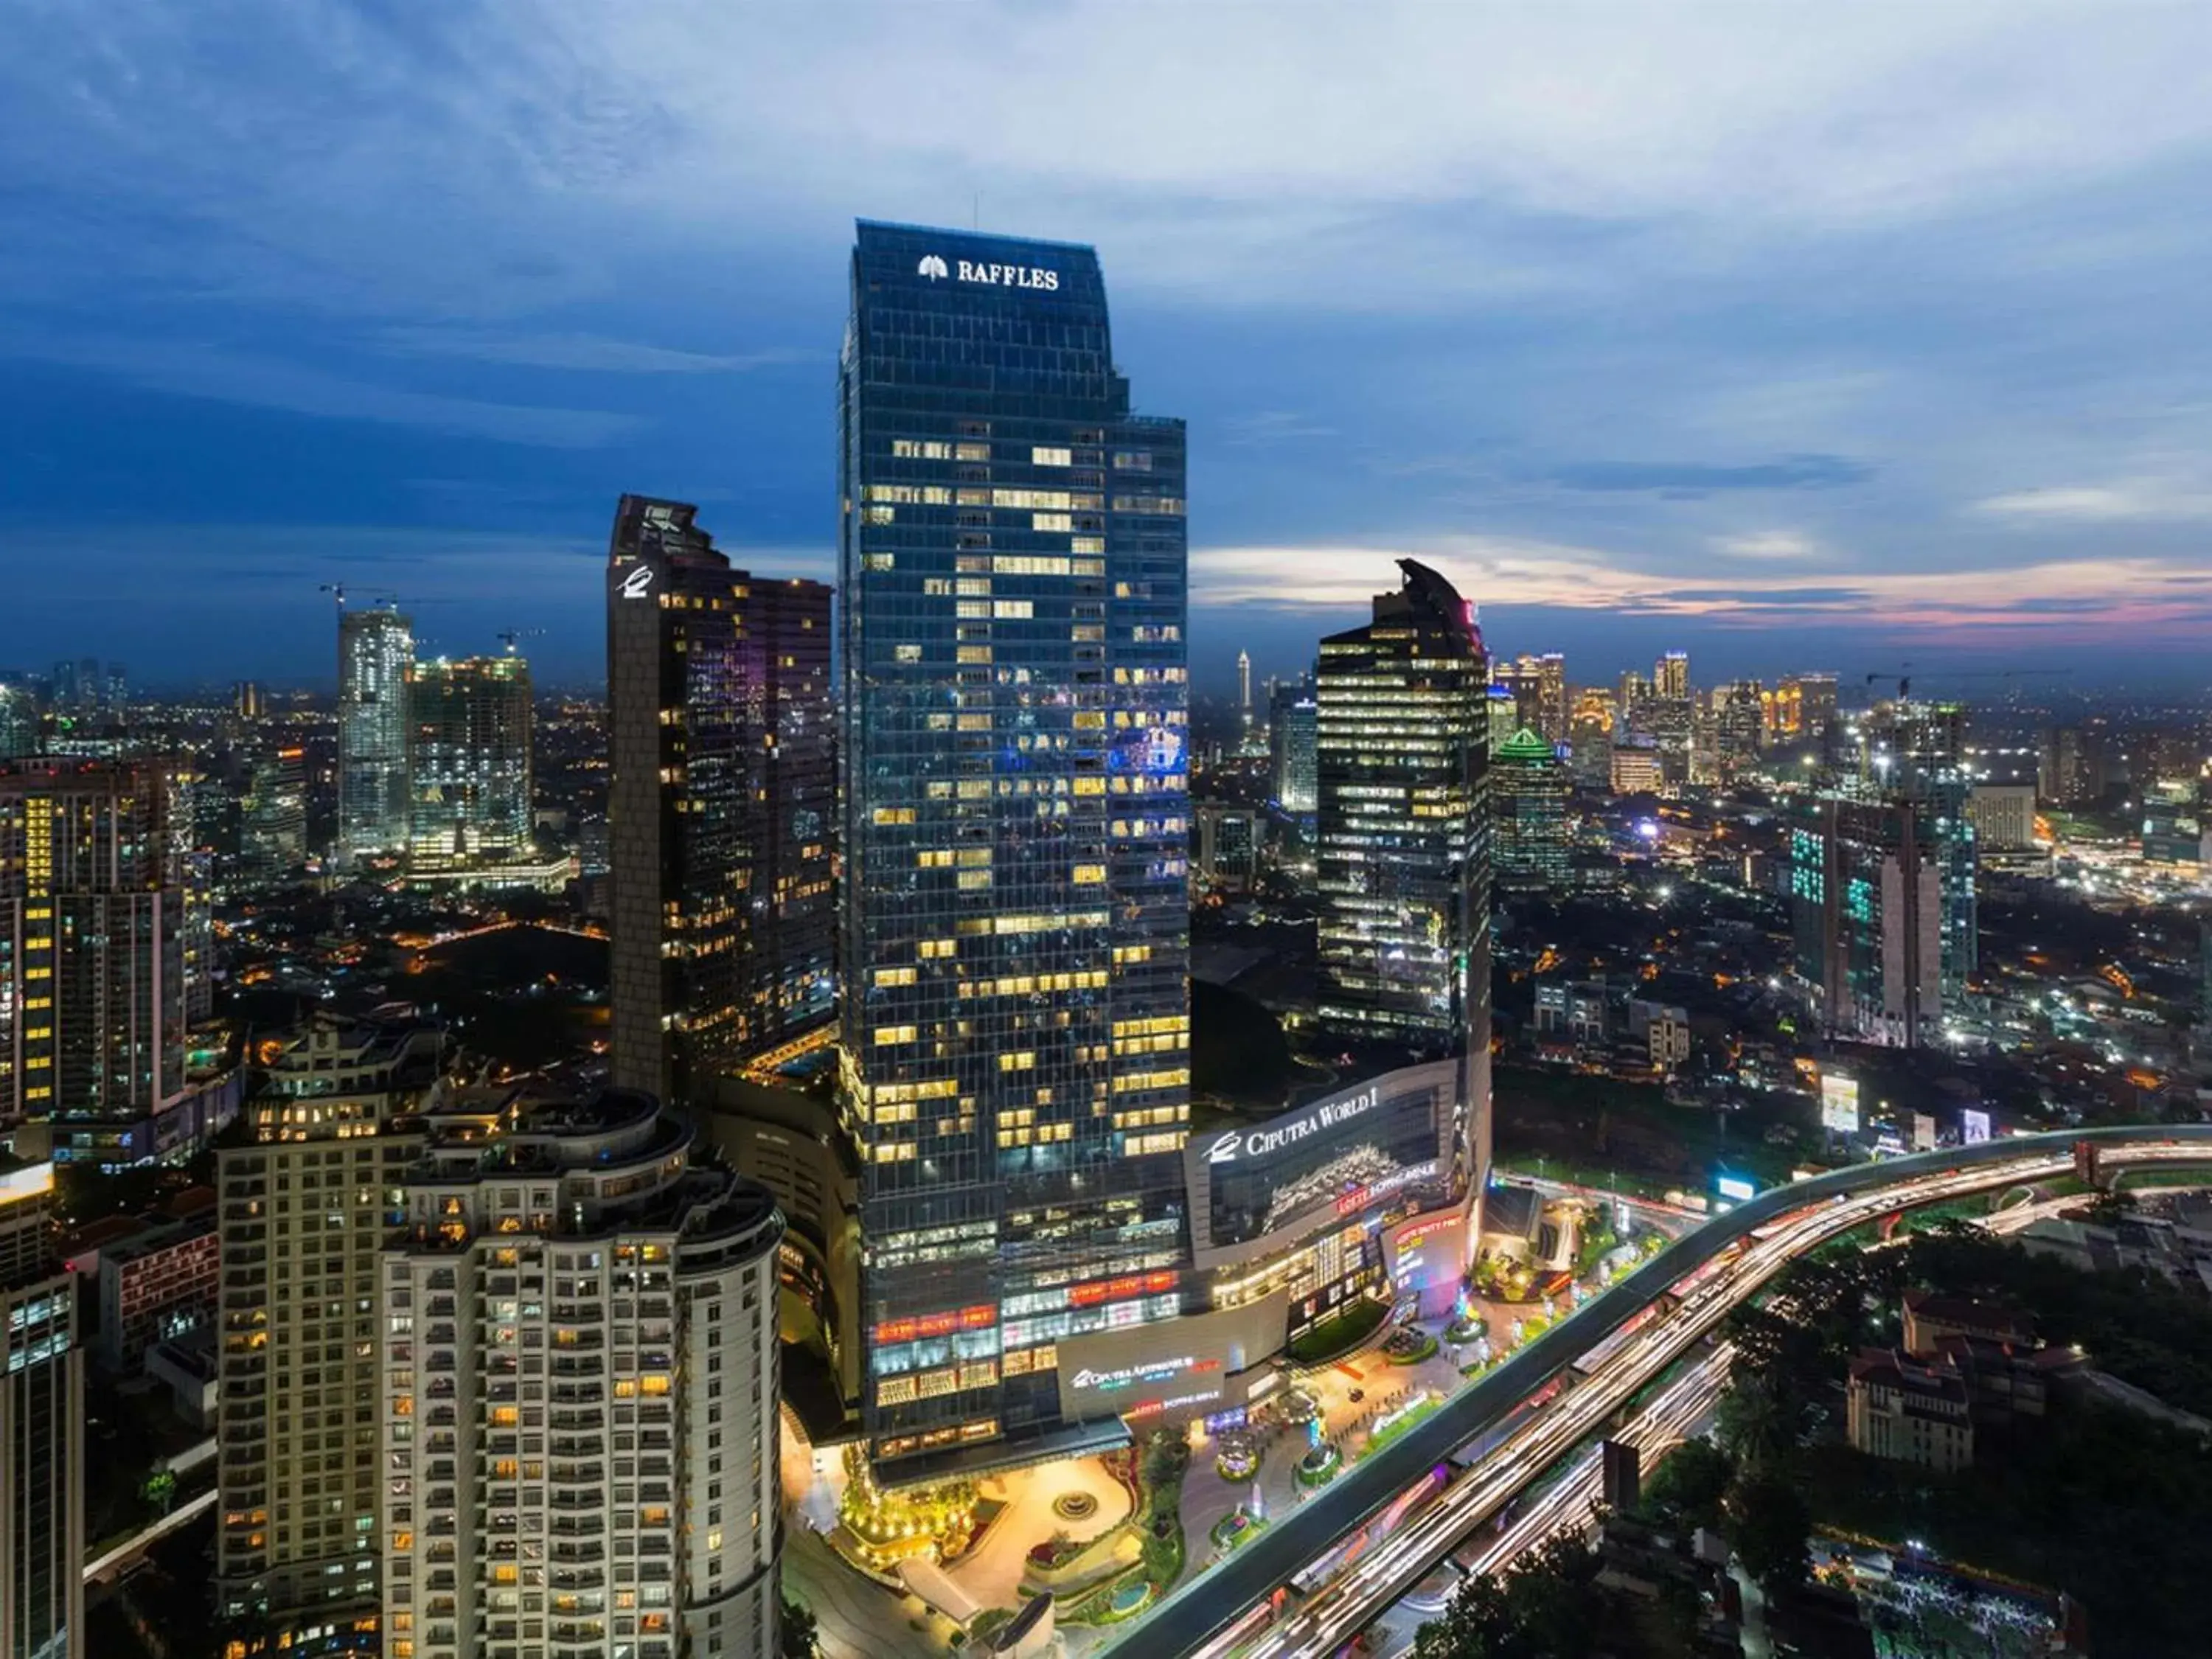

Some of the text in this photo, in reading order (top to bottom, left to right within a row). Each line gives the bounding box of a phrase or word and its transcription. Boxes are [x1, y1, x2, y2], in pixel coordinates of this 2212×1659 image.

[959, 261, 1058, 291] RAFFLES
[1246, 1116, 1318, 1156] CIPUTRA
[1318, 1095, 1369, 1128] WORLD
